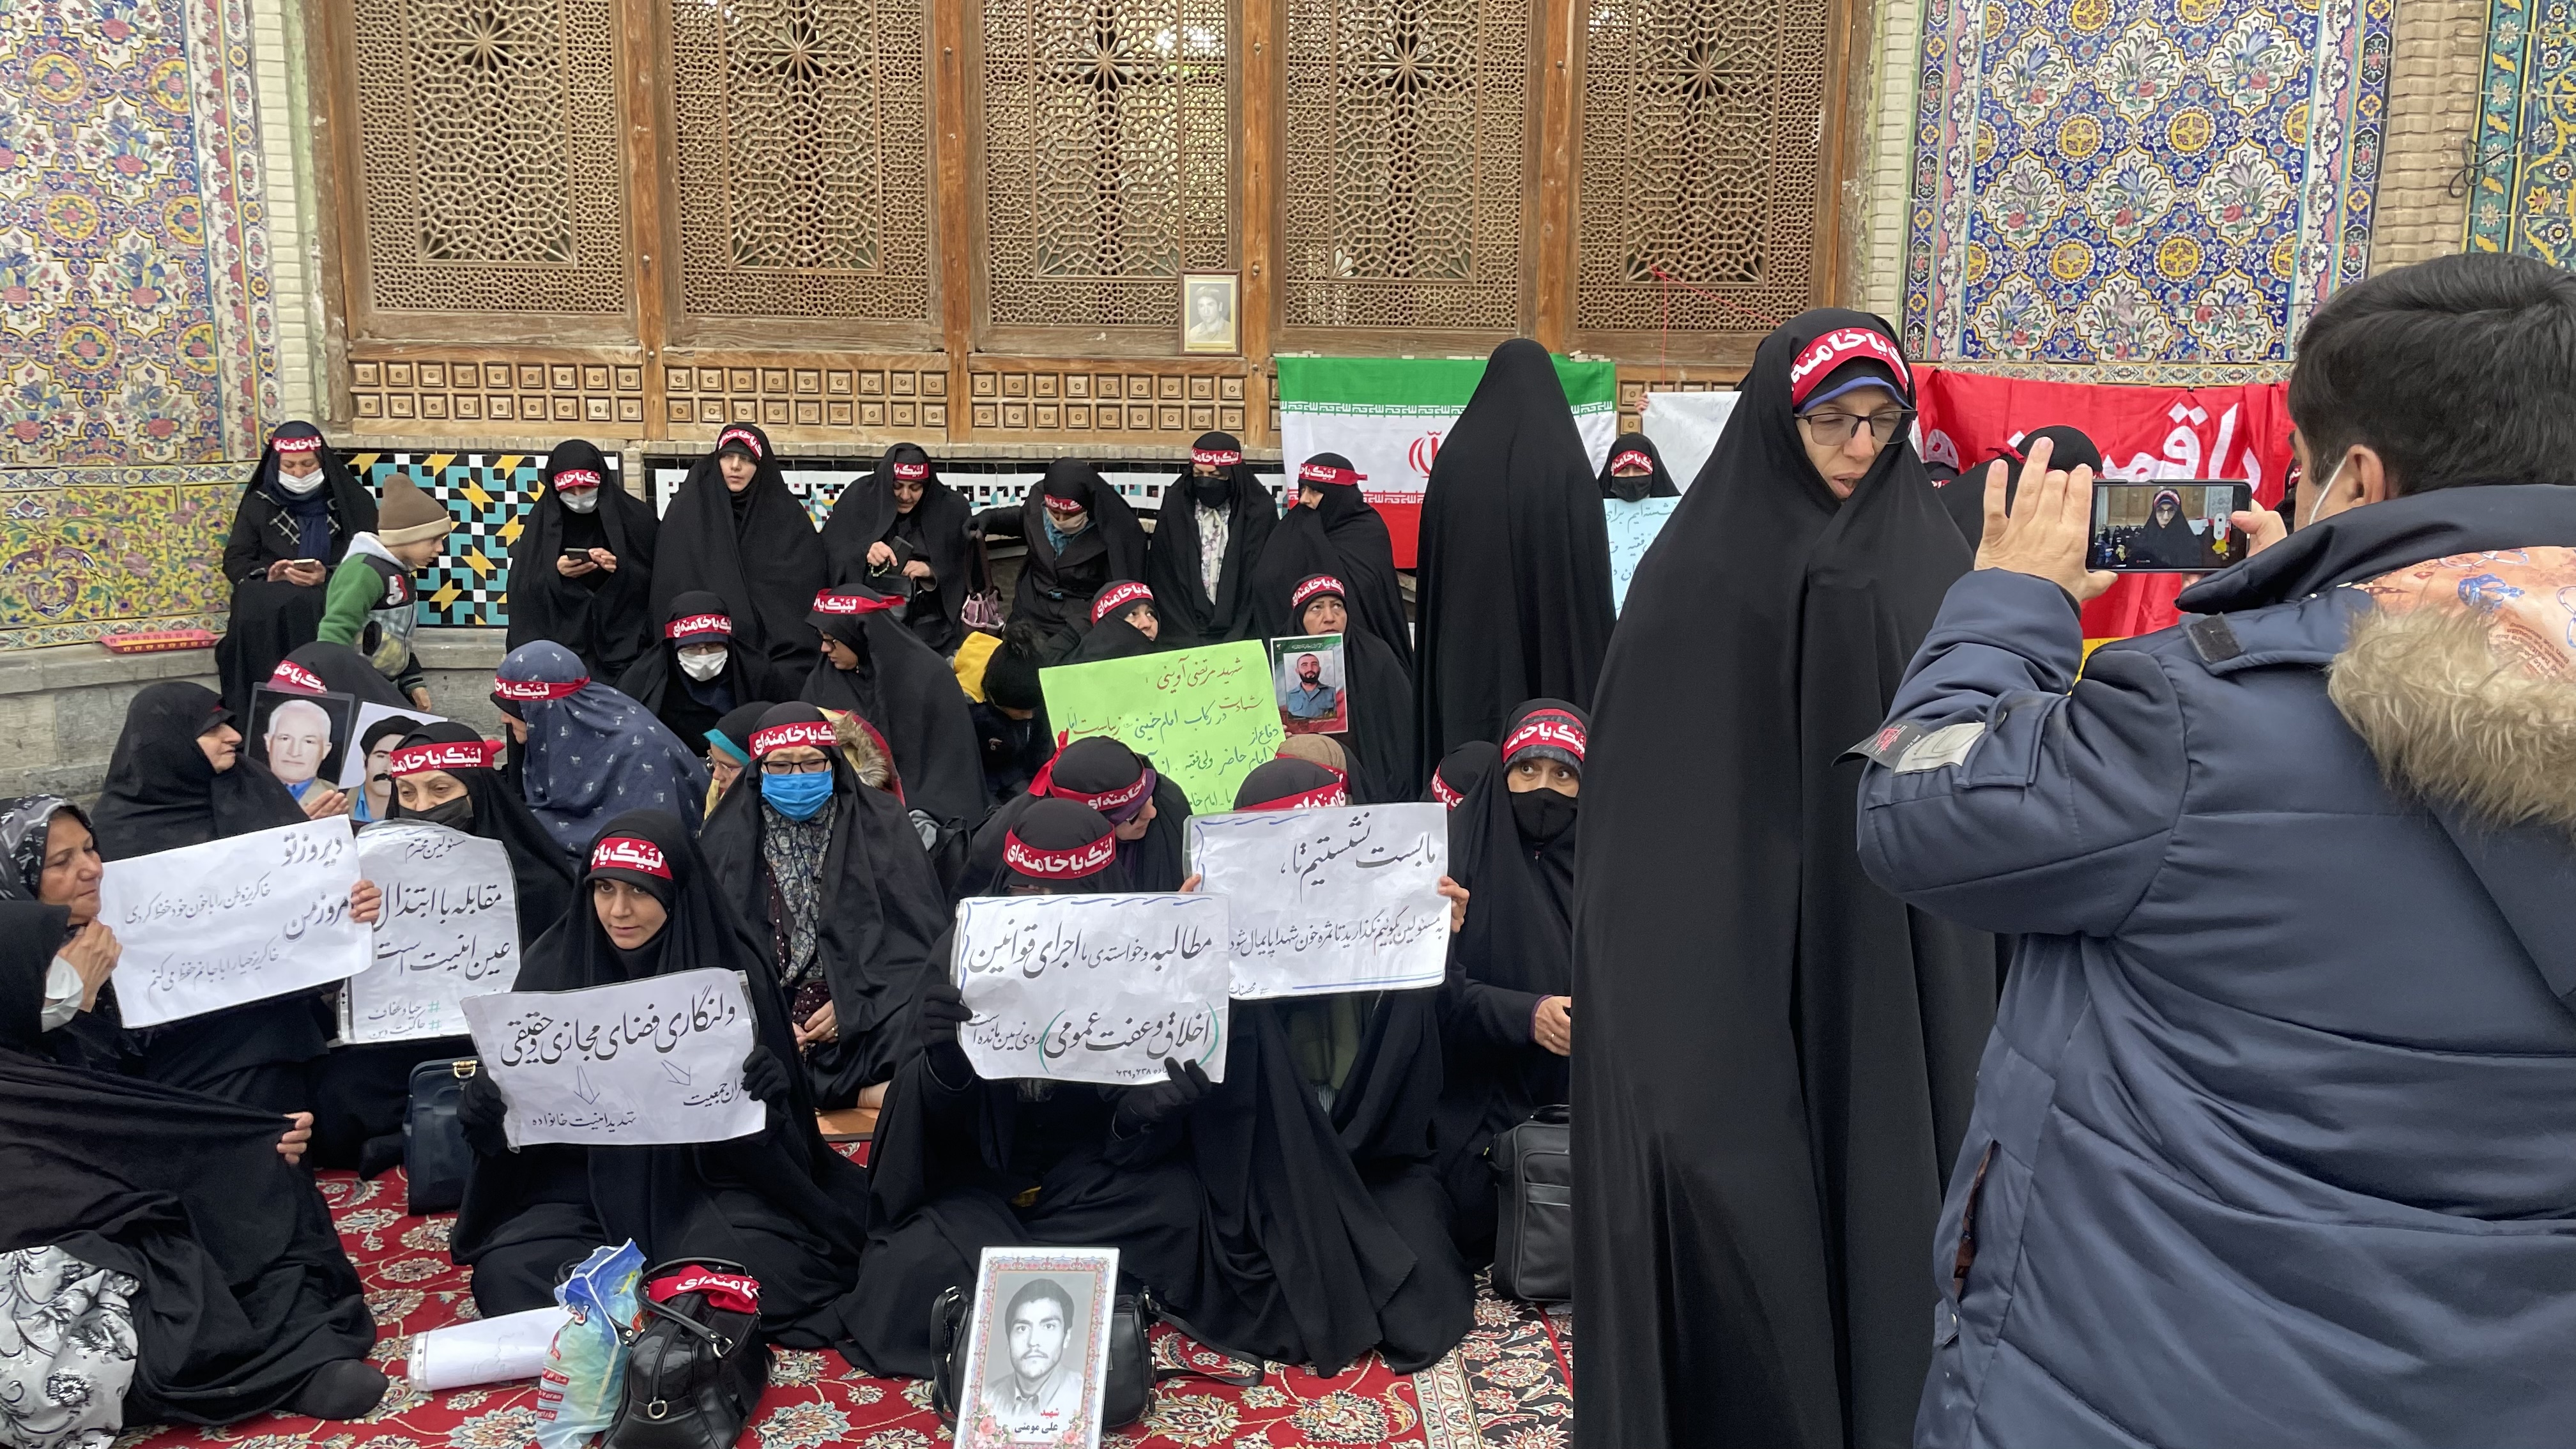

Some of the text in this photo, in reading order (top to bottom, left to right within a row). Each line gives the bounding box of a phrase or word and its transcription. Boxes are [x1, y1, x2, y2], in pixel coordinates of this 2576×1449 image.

[1874, 332, 1889, 356] یا
[1791, 327, 1867, 392] خامنه
[900, 464, 924, 477] لبیک
[1220, 451, 1239, 463] لبیک
[1312, 467, 1337, 480] لبیک
[827, 598, 857, 613] لبیک
[673, 615, 710, 638] خامنه‌ای
[1157, 654, 1243, 694] شهید مرتضی آوینی
[512, 682, 549, 700] لبیک
[1219, 696, 1264, 713] شهادت
[1134, 712, 1162, 741] خمینی
[1160, 709, 1178, 744] امام
[1184, 700, 1216, 732] رکاب
[1215, 712, 1227, 725] در
[753, 724, 818, 756] یا خامنه‌ای
[1248, 723, 1279, 746] دفاع از
[1538, 722, 1551, 740] یا
[425, 750, 441, 769] یا
[447, 747, 482, 767] لبیک
[1184, 750, 1200, 779] فقیه
[1197, 749, 1213, 770] ولی
[1218, 746, 1247, 776] حاضر
[1248, 746, 1268, 772] امام
[1204, 790, 1218, 813] امام
[281, 832, 343, 868] دیروز تو
[406, 838, 429, 864] محترم
[600, 843, 611, 866] یا
[613, 841, 664, 871] لبیک
[1008, 836, 1113, 875] لبیک یا خامنه‌ای
[1300, 811, 1372, 905] نشستیم
[1427, 832, 1436, 864] ما
[125, 891, 163, 924] کردی
[155, 899, 171, 920] حفظ
[171, 898, 188, 917] خود
[185, 894, 208, 919] خون
[373, 881, 502, 932] مقابله با ابتذال
[283, 901, 318, 942] من
[1275, 925, 1298, 946] شهدا
[1317, 921, 1333, 949] ثمره
[1335, 923, 1347, 941] تا
[1341, 908, 1386, 949] نگذارید
[1393, 915, 1441, 946] مسئولین
[1435, 927, 1444, 940] به
[968, 919, 1039, 974] قوانین
[1022, 921, 1083, 979] اجرای
[1150, 923, 1213, 971] مطالبه
[1229, 929, 1248, 951] شود
[1241, 928, 1276, 958] پایمال
[1295, 924, 1319, 953] خون
[377, 934, 511, 981] عین امنیت است
[148, 951, 175, 1003] کنم
[161, 971, 174, 992] می
[193, 961, 218, 992] جانم
[594, 1002, 661, 1061] فضای
[654, 984, 735, 1054] ولنگاری
[501, 1011, 555, 1067] حقیقی
[540, 1018, 601, 1064] مجازی
[1085, 1017, 1151, 1052] عفت
[683, 1082, 728, 1108] جمعیت
[532, 1111, 637, 1133] تهدید امنیت خانواده
[1040, 1407, 1060, 1418] شهید
[1014, 1422, 1059, 1434] علی مومنی
